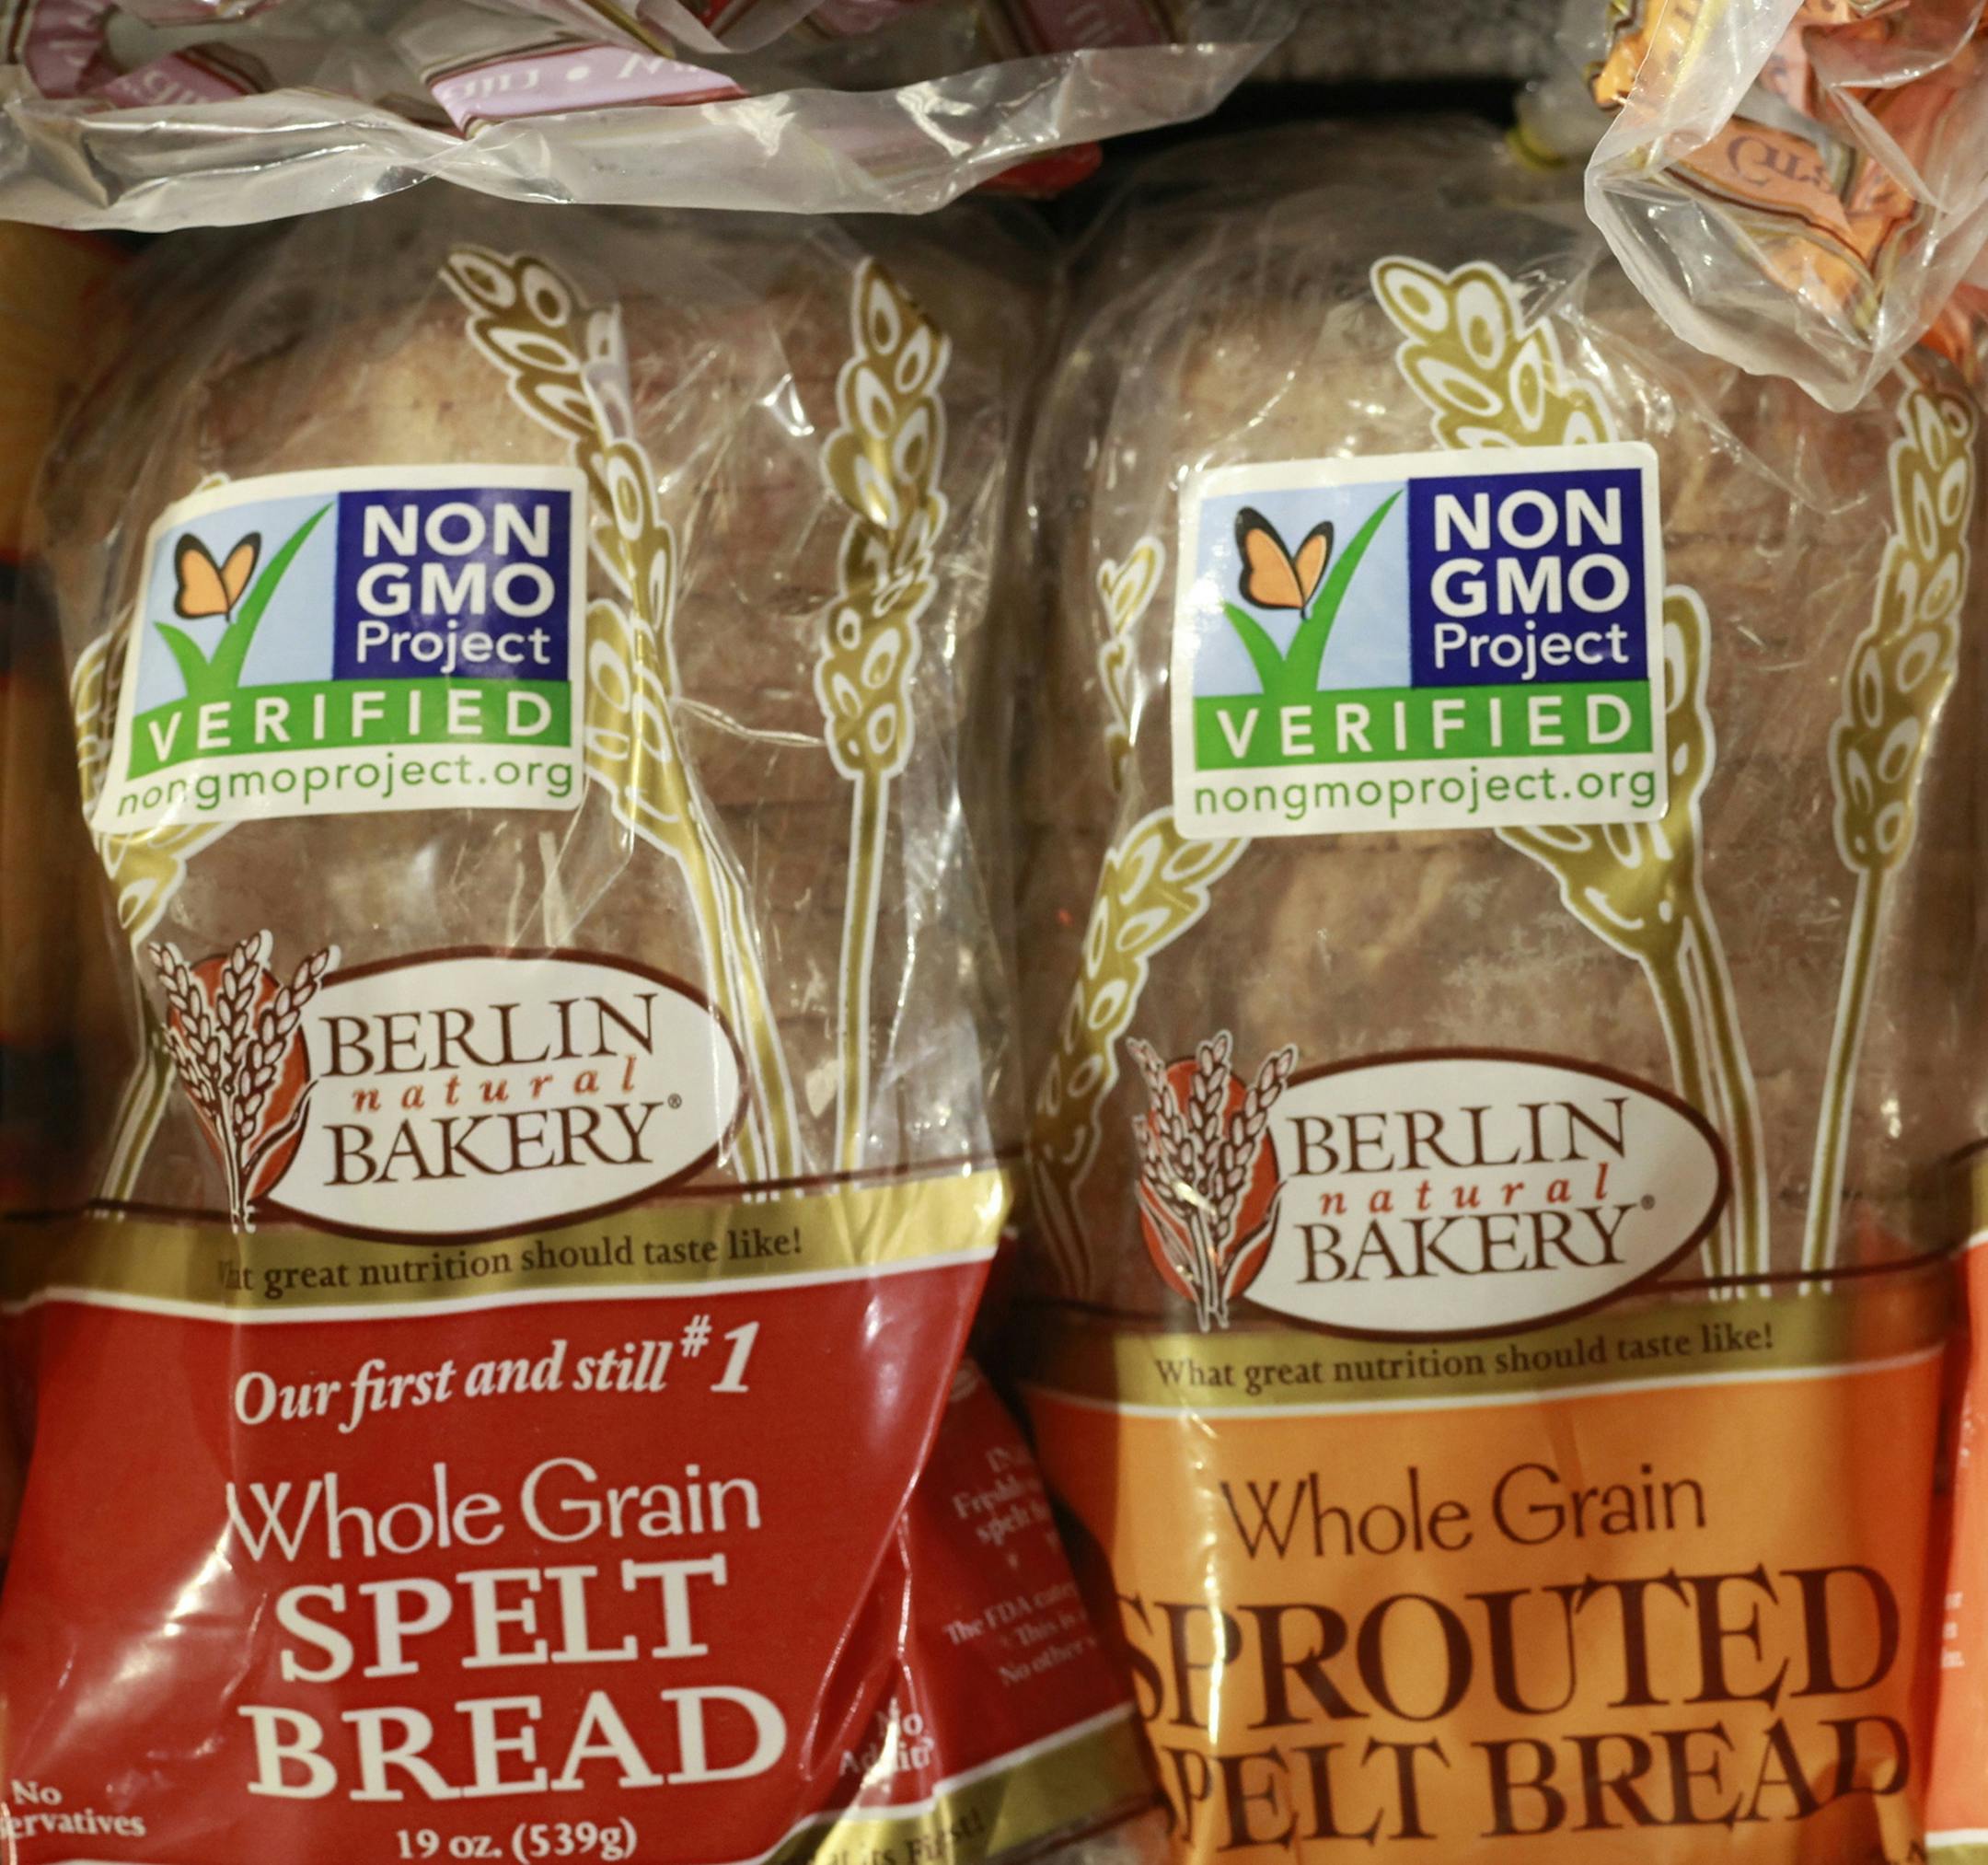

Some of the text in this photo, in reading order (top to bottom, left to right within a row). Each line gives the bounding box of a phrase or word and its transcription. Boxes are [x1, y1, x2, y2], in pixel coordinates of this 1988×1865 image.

[363, 502, 549, 558] NON
[1433, 487, 1623, 552] NON
[356, 562, 555, 618] GMO
[1430, 553, 1631, 618] GMO
[356, 620, 550, 673] Project
[1433, 620, 1629, 680] Project
[148, 689, 552, 764] VERIFIED
[1217, 694, 1633, 759] VERIFIED
[117, 751, 572, 817] nongmoproject.org
[1196, 766, 1656, 820] nongmoproject.org
[318, 992, 659, 1078] BERLIN
[353, 1054, 637, 1114] natural
[1286, 1096, 1630, 1177] BERLIN
[1320, 1162, 1609, 1217] natural
[263, 1263, 350, 1300] great
[359, 1243, 514, 1286] nutrition
[520, 1236, 634, 1271] should
[643, 1238, 719, 1267] taste
[727, 1227, 803, 1260] like!
[234, 1371, 342, 1426] Our
[338, 1358, 457, 1435] first
[463, 1338, 570, 1398] and
[572, 1338, 674, 1394] still
[1156, 1322, 1774, 1396] What great nutrition should taste like!
[225, 1456, 761, 1562] Whole Grain
[1219, 1461, 1707, 1560] Whole Grain
[275, 1553, 728, 1684] SPELT
[237, 1685, 788, 1801] BREAD
[11, 1779, 63, 1805] No
[1150, 1714, 1912, 1852] PELT BREAD
[397, 1816, 639, 1865] 19 oz. (539g)
